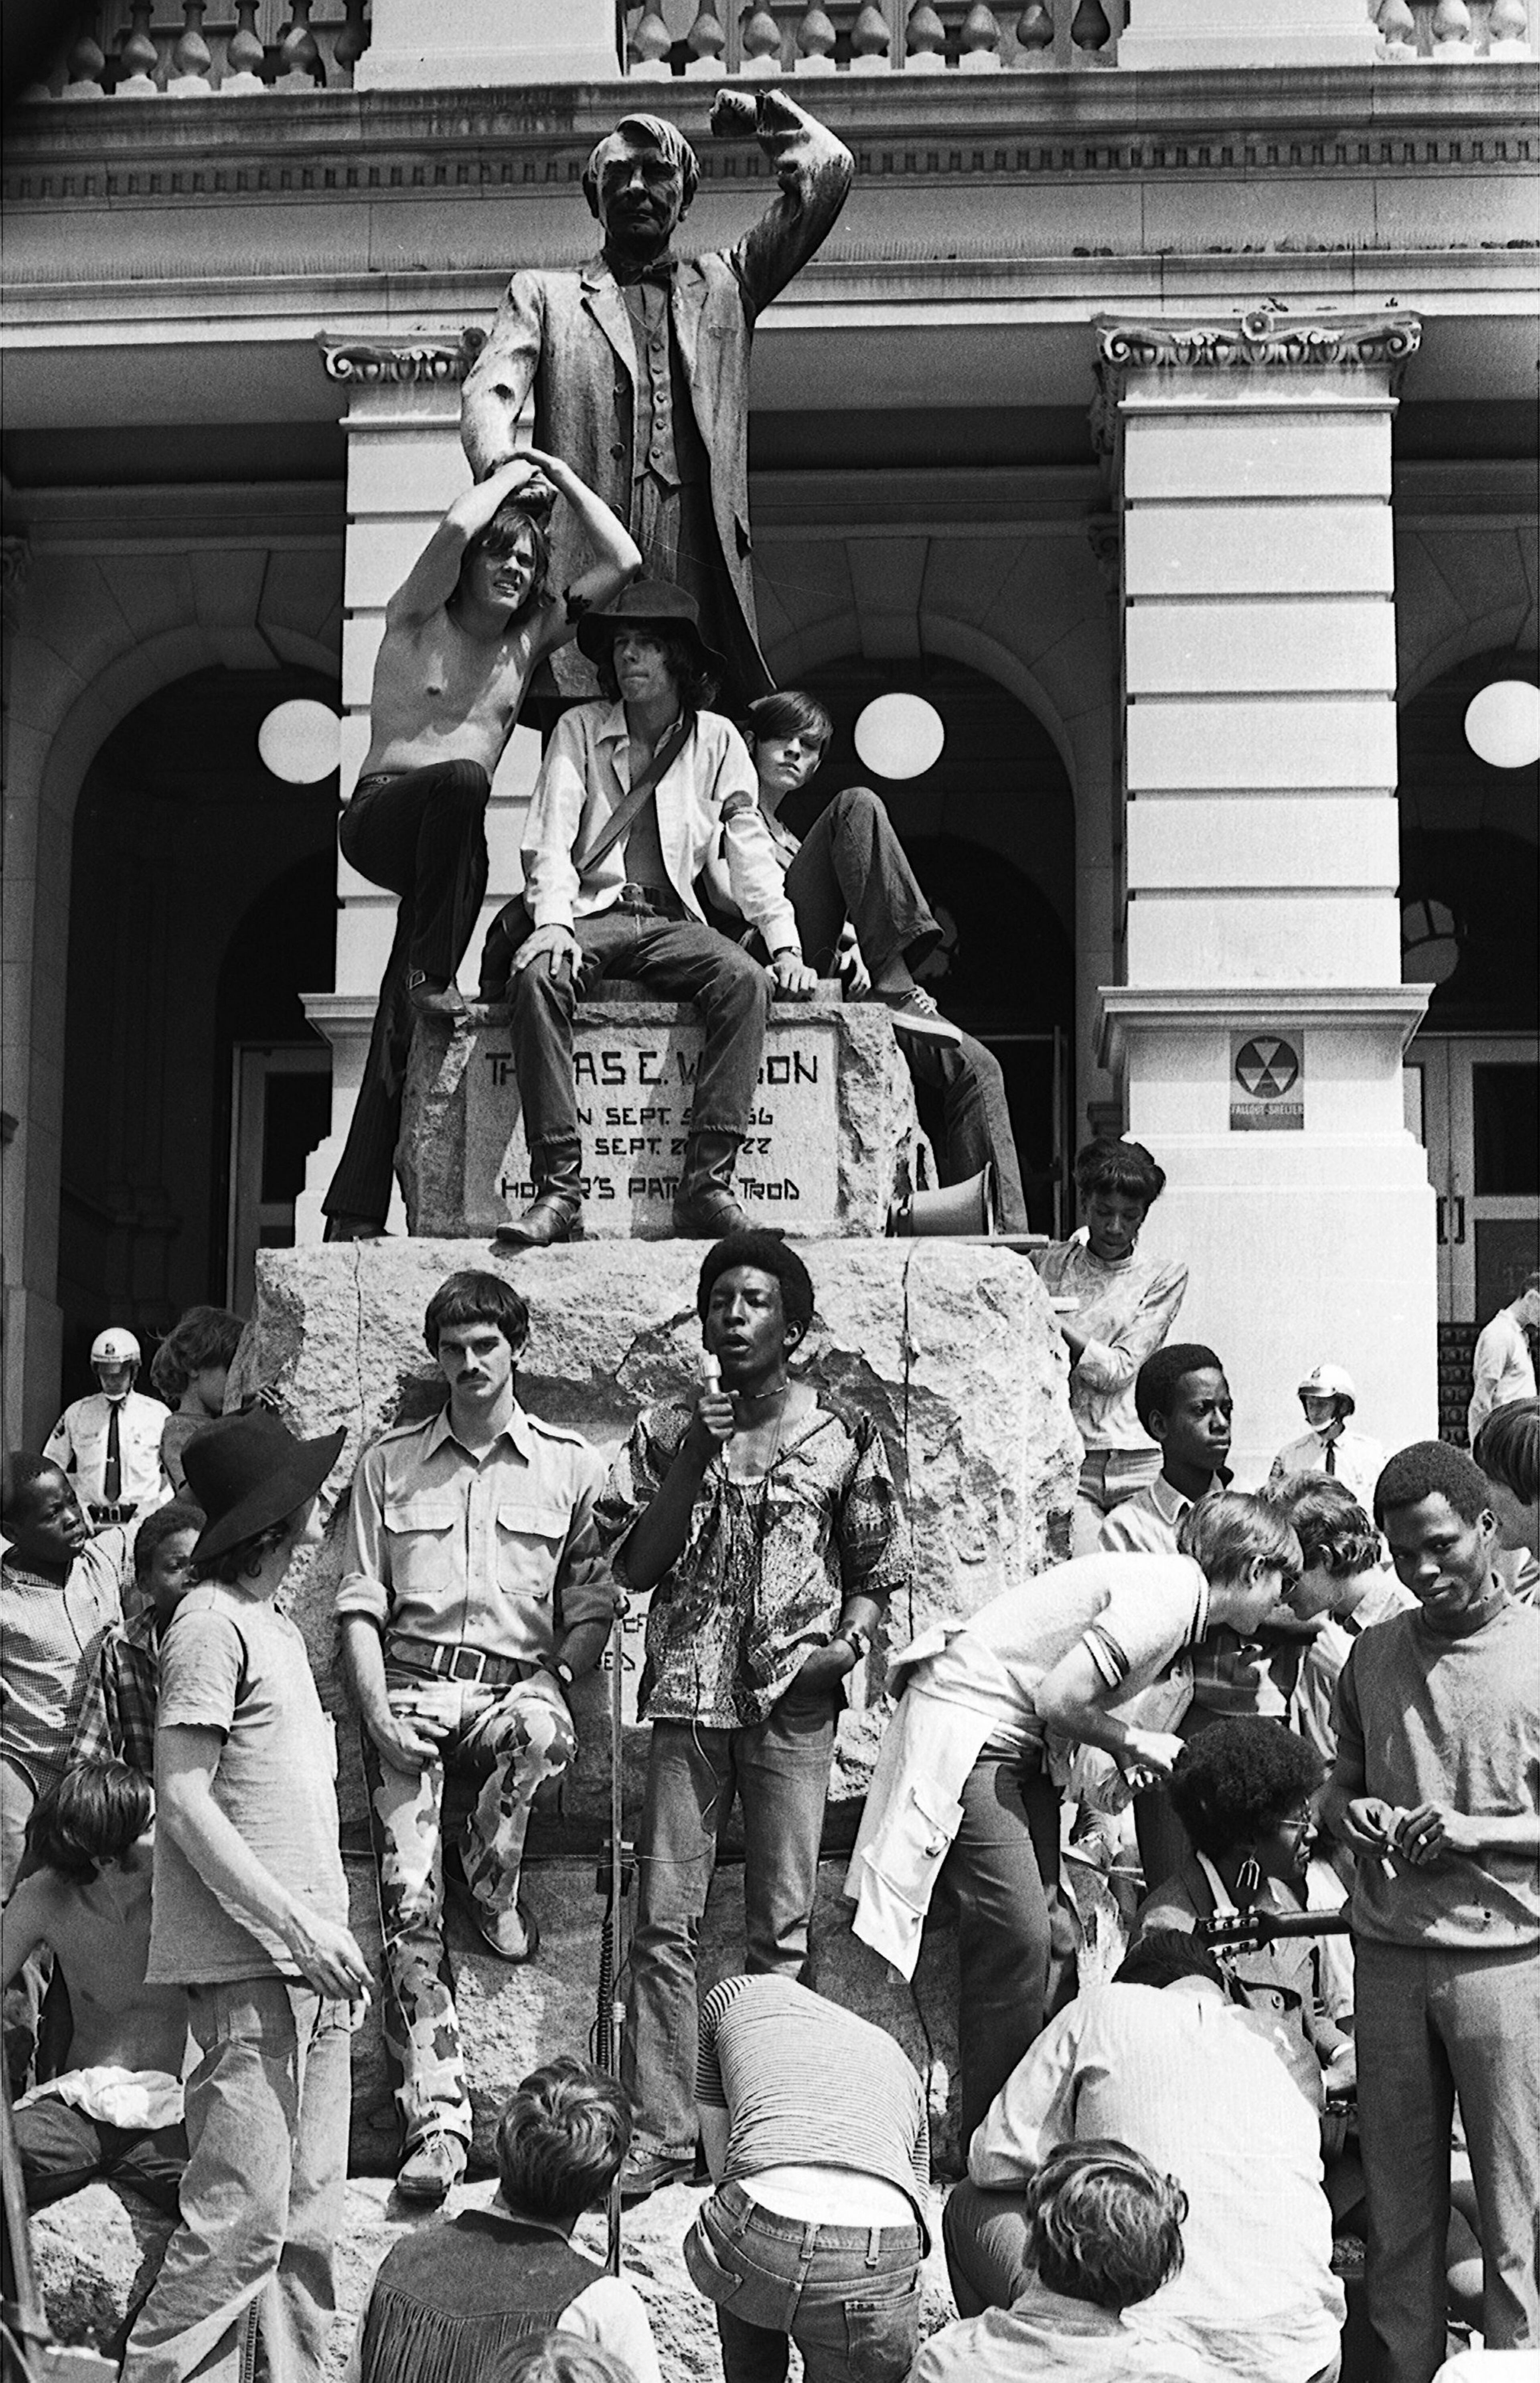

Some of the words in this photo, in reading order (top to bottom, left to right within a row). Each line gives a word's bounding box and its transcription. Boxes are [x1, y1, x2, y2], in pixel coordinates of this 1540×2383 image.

[486, 1052, 626, 1085] THAS
[677, 1051, 817, 1084] WON
[606, 1107, 672, 1125] SEPT.
[595, 1138, 661, 1155] SEPT.
[502, 1176, 615, 1200] HOR'S
